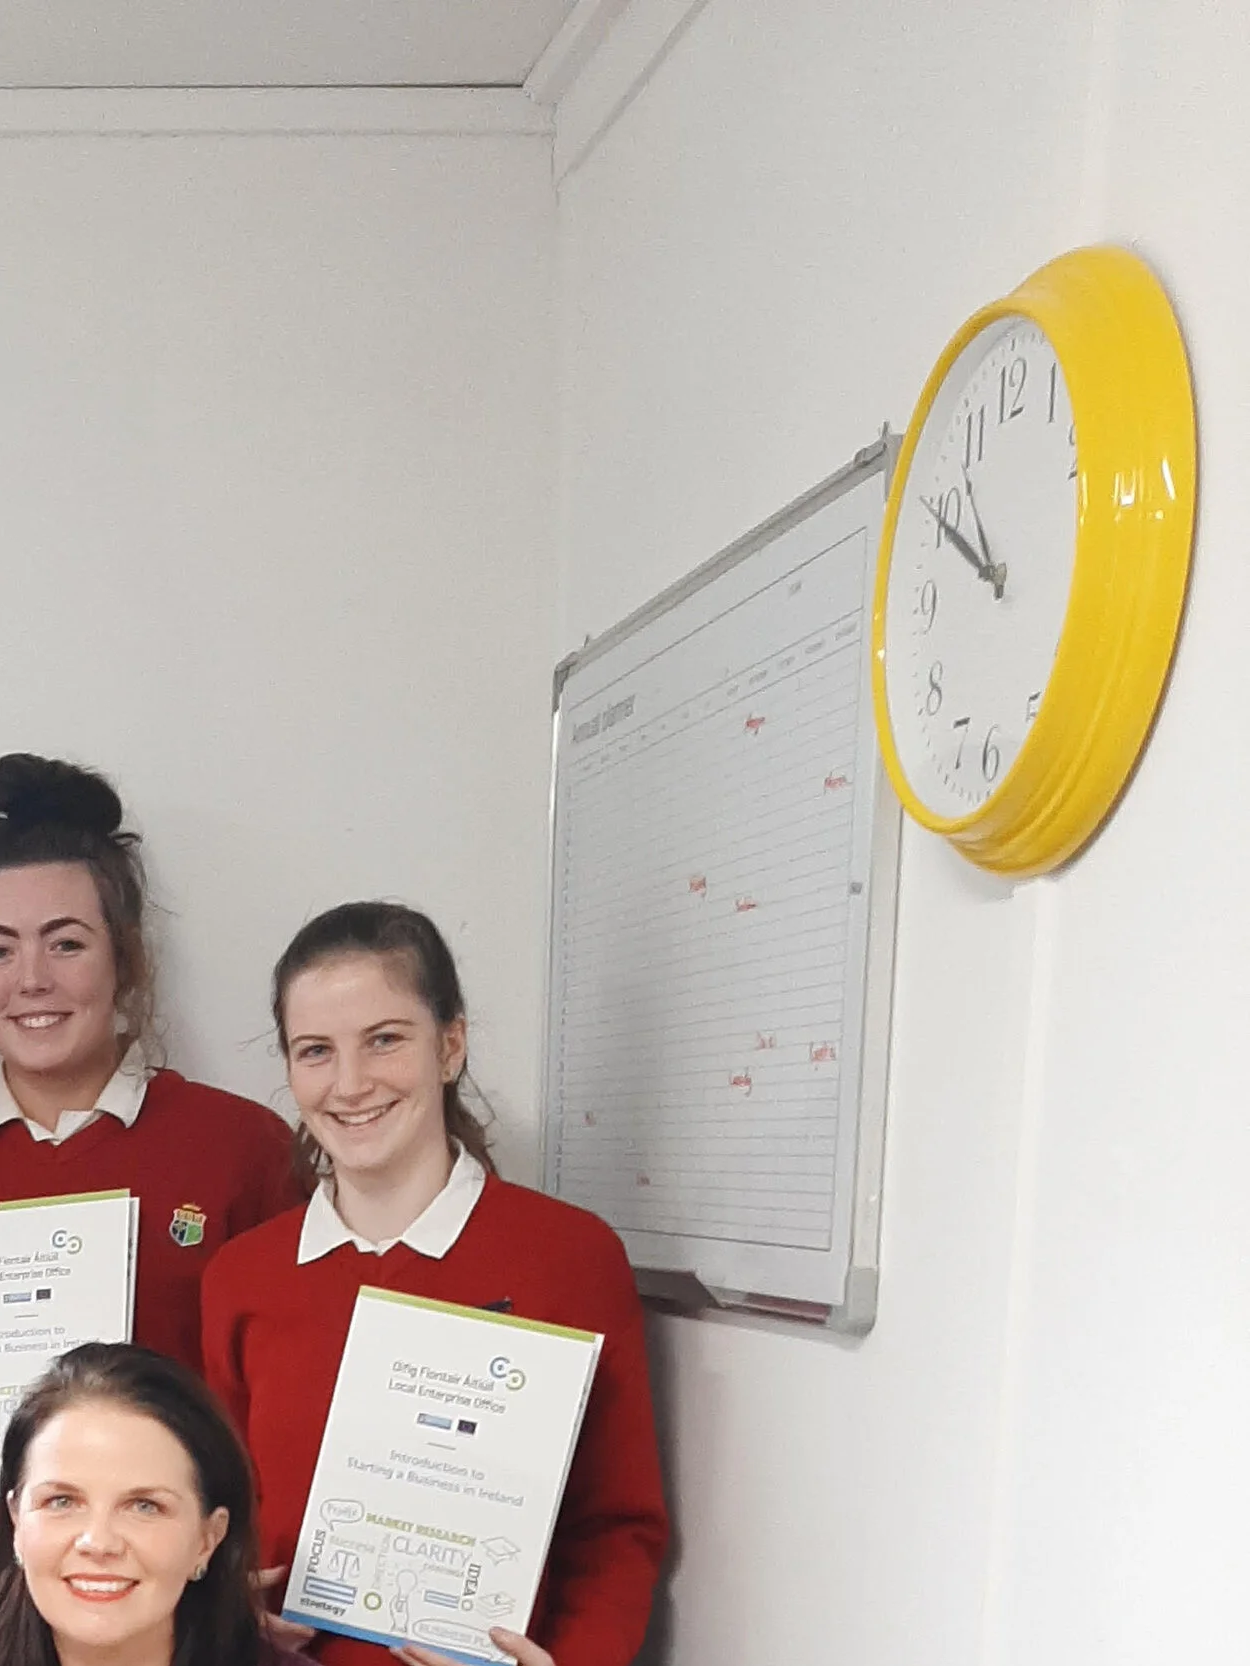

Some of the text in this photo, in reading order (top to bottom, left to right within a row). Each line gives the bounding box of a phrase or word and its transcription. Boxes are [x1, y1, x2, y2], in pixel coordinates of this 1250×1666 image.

[999, 357, 1027, 424] 12
[1048, 362, 1057, 423] 1
[965, 404, 985, 468] 11
[936, 486, 961, 549] 10
[920, 579, 938, 635] 9
[926, 660, 943, 716] 8
[953, 717, 971, 770] 7
[982, 724, 1000, 782] 6
[393, 1537, 473, 1569] CLARITY
